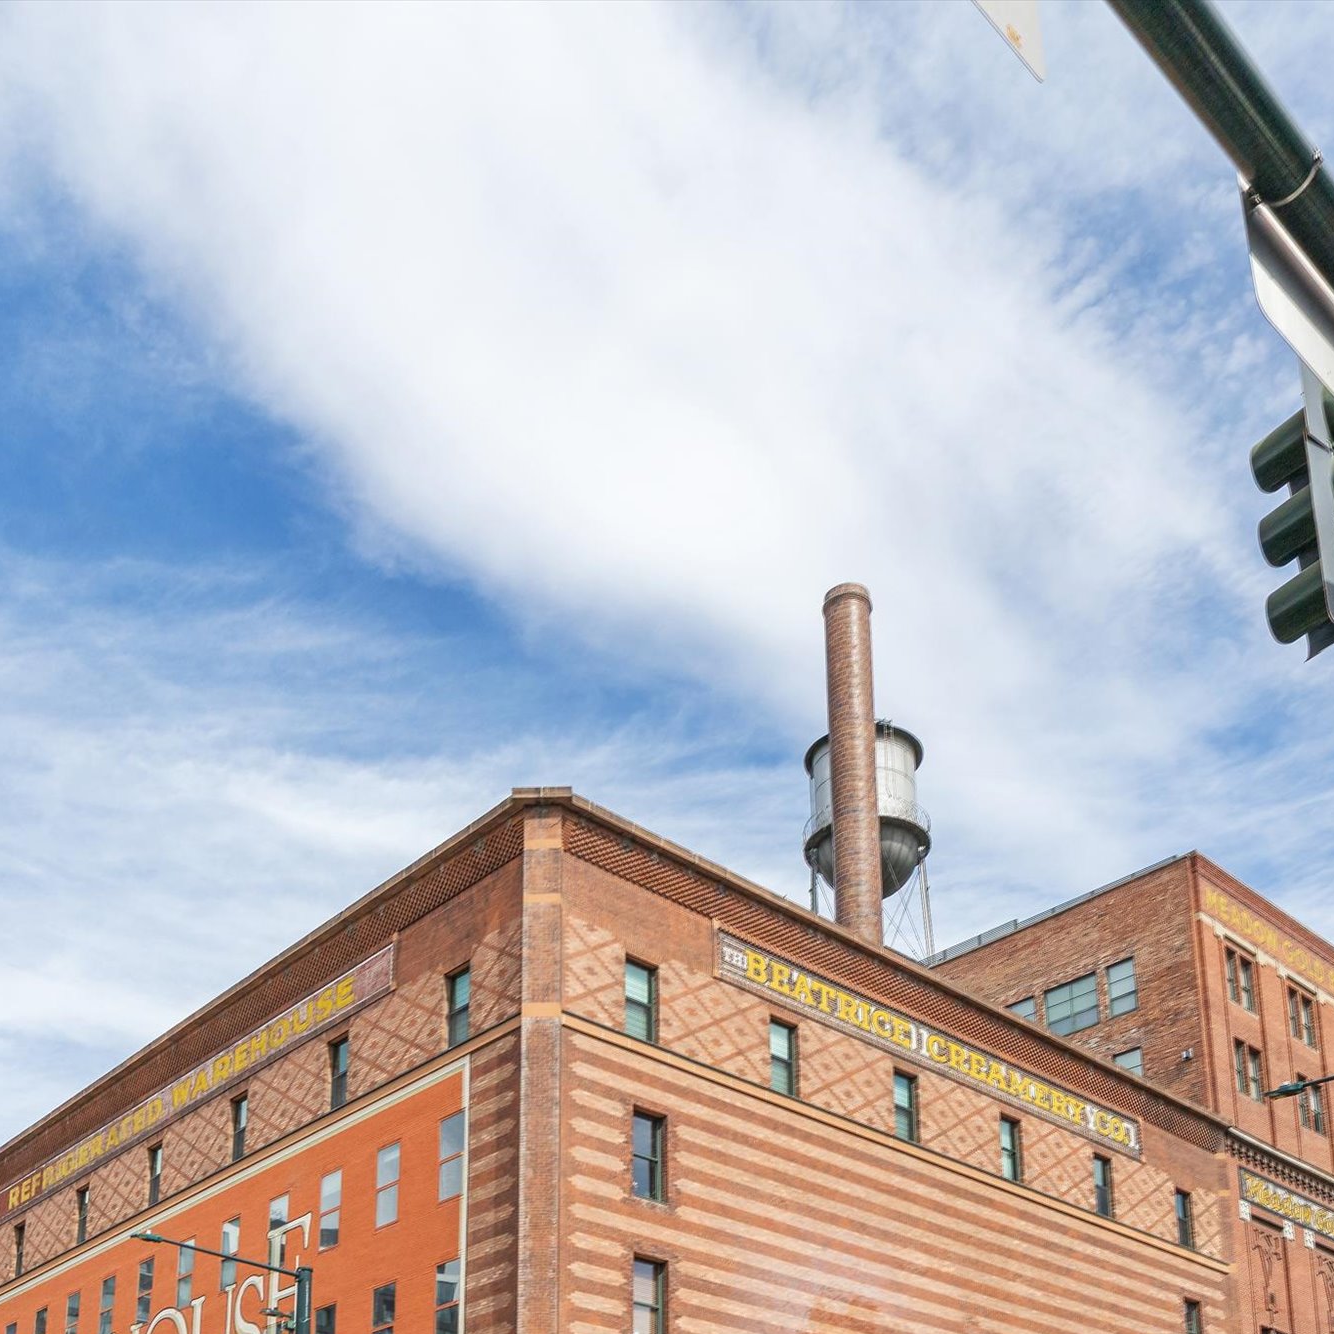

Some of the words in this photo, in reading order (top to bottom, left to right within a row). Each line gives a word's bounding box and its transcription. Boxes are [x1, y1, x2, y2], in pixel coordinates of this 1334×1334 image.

[8, 1096, 164, 1211] REFRIGERATED
[171, 976, 356, 1111] WAREHOUSE
[745, 948, 912, 1049] BEATRICE
[927, 1034, 1086, 1126] CREAMERY
